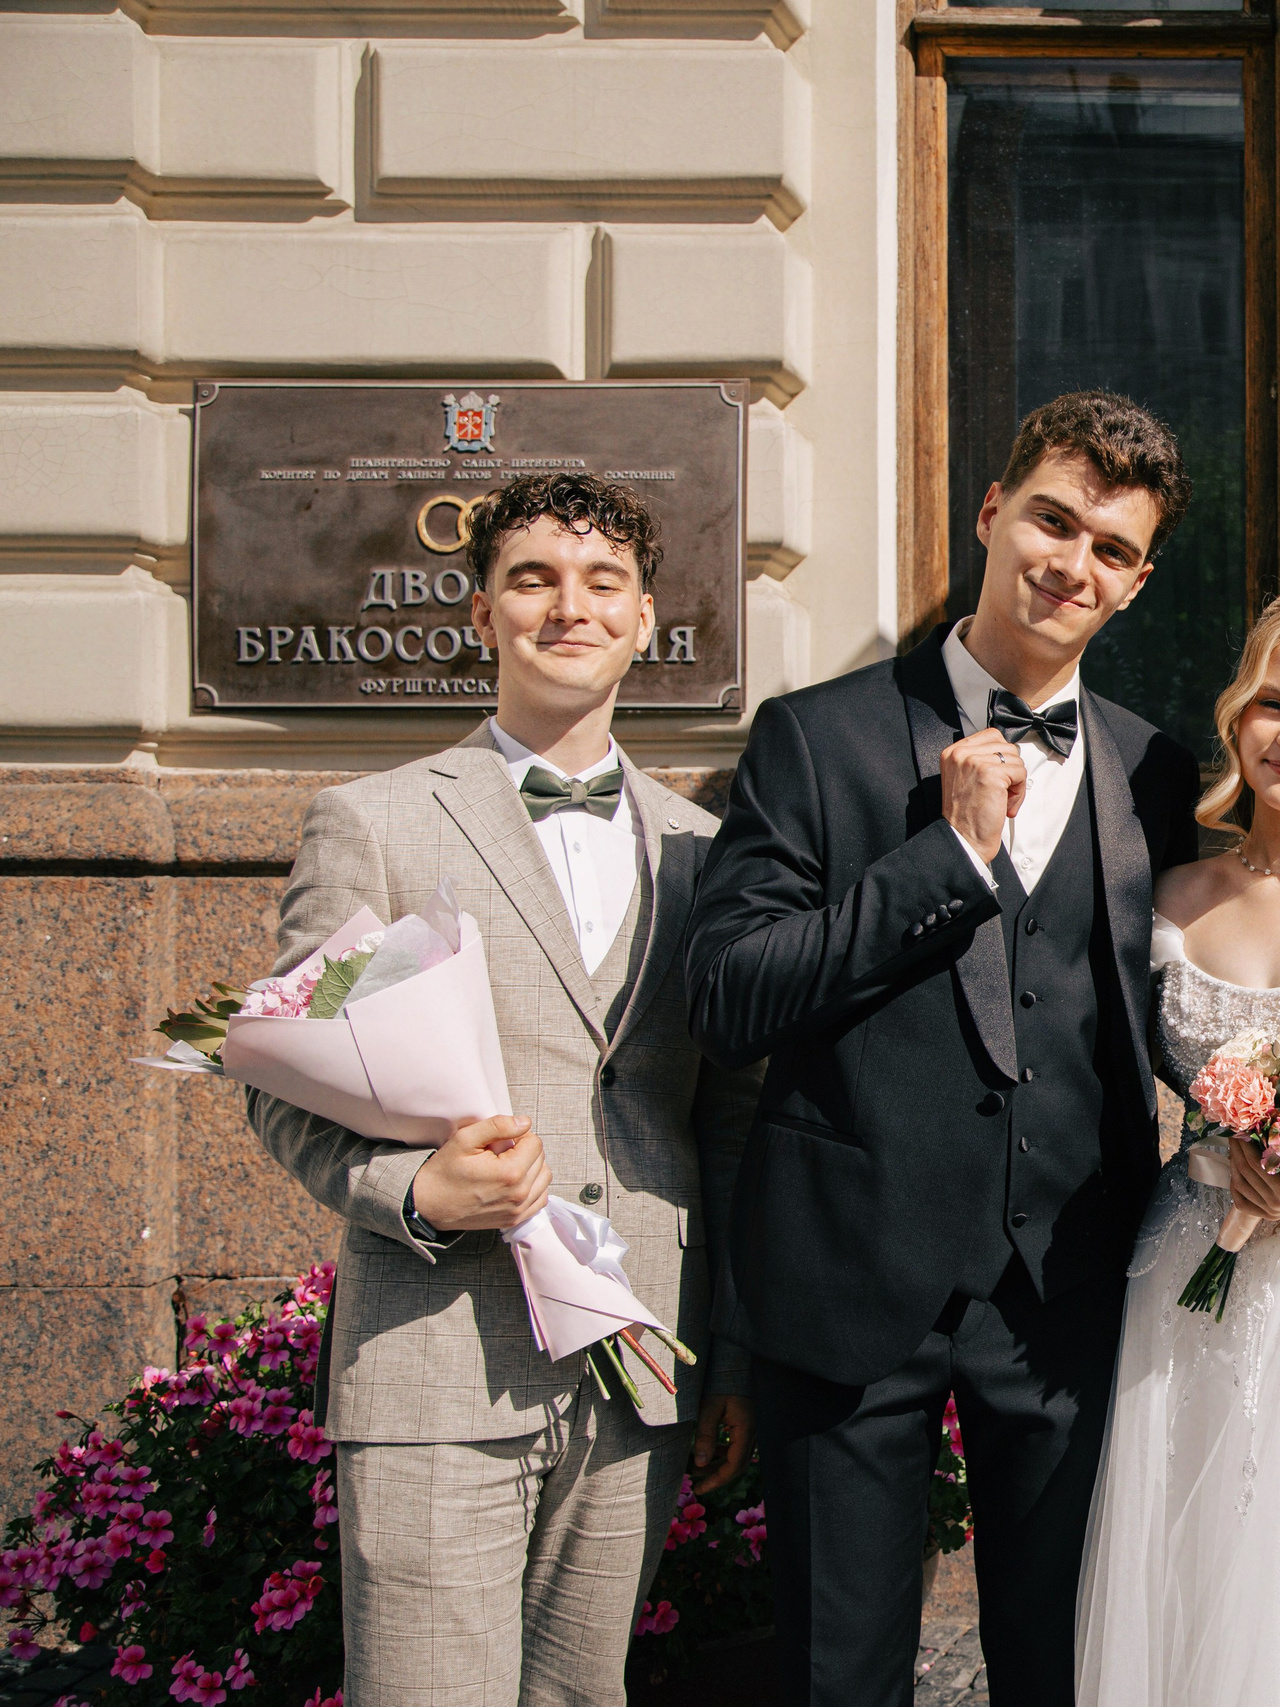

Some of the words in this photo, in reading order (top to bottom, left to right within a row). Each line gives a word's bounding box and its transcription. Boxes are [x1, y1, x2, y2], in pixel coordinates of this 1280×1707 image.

[350, 457, 451, 468] ПРАВИТЕЛЬСТВО
[260, 469, 317, 480] КОМИТЕТ
[323, 469, 342, 480] ПО
[346, 469, 390, 482] ДЕЛАМ
[398, 469, 446, 480] ЗАПИСИ
[452, 469, 493, 480] АКТОВ
[603, 470, 676, 481] СОСТОЯНИЯ
[361, 569, 486, 612] ДВО
[236, 625, 697, 664] БРАКОСОЧЯ
[359, 678, 500, 695] ФУРШТАТСК
